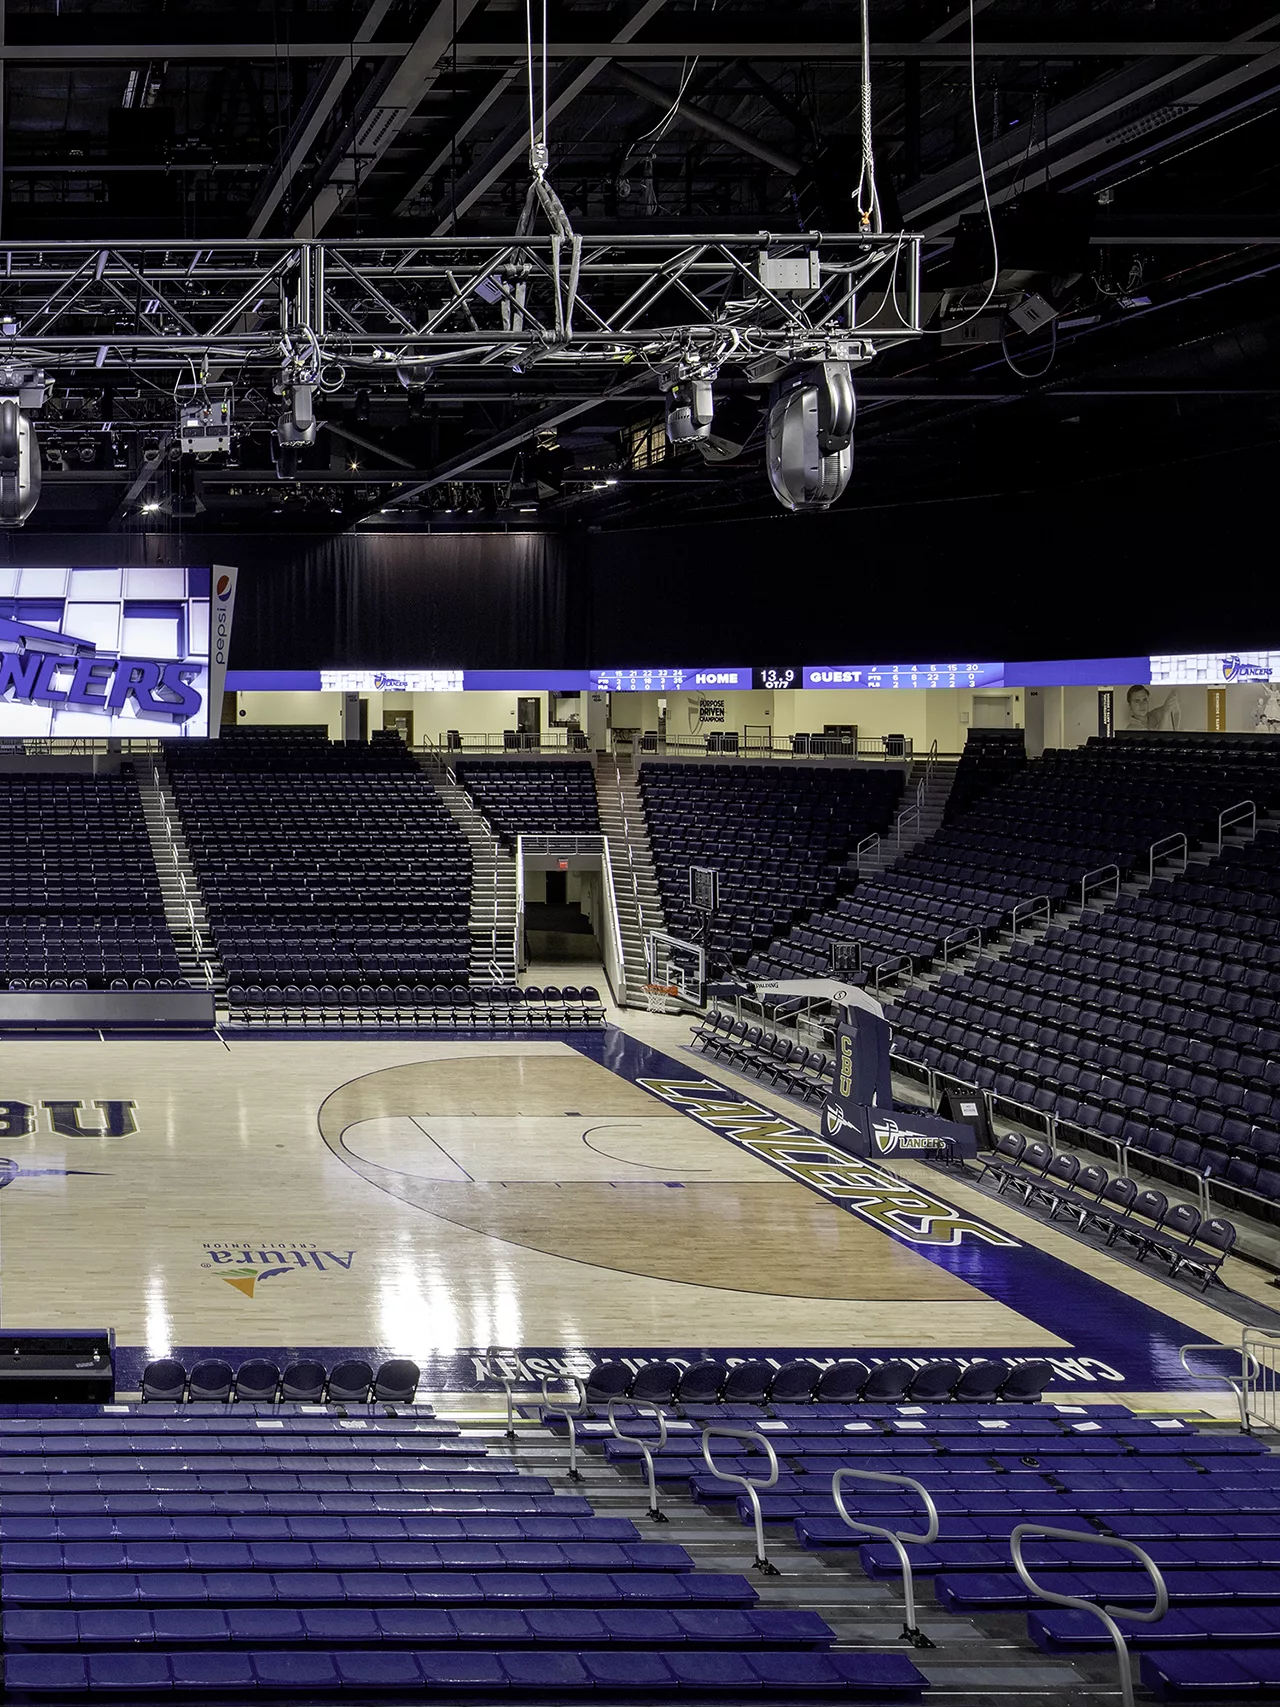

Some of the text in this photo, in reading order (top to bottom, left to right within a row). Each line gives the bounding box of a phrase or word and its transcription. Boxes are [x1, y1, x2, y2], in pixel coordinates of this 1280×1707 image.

[216, 607, 228, 665] pepsi
[760, 670, 794, 682] 13.9
[810, 671, 861, 682] GUEST
[1239, 667, 1273, 675] LANCERS
[695, 674, 738, 684] HOME
[699, 700, 724, 708] PURPOSE
[699, 708, 724, 716] DRIVEN
[840, 1035, 852, 1097] CBU
[636, 1077, 1022, 1248] LANCERS
[206, 1250, 357, 1271] Altura
